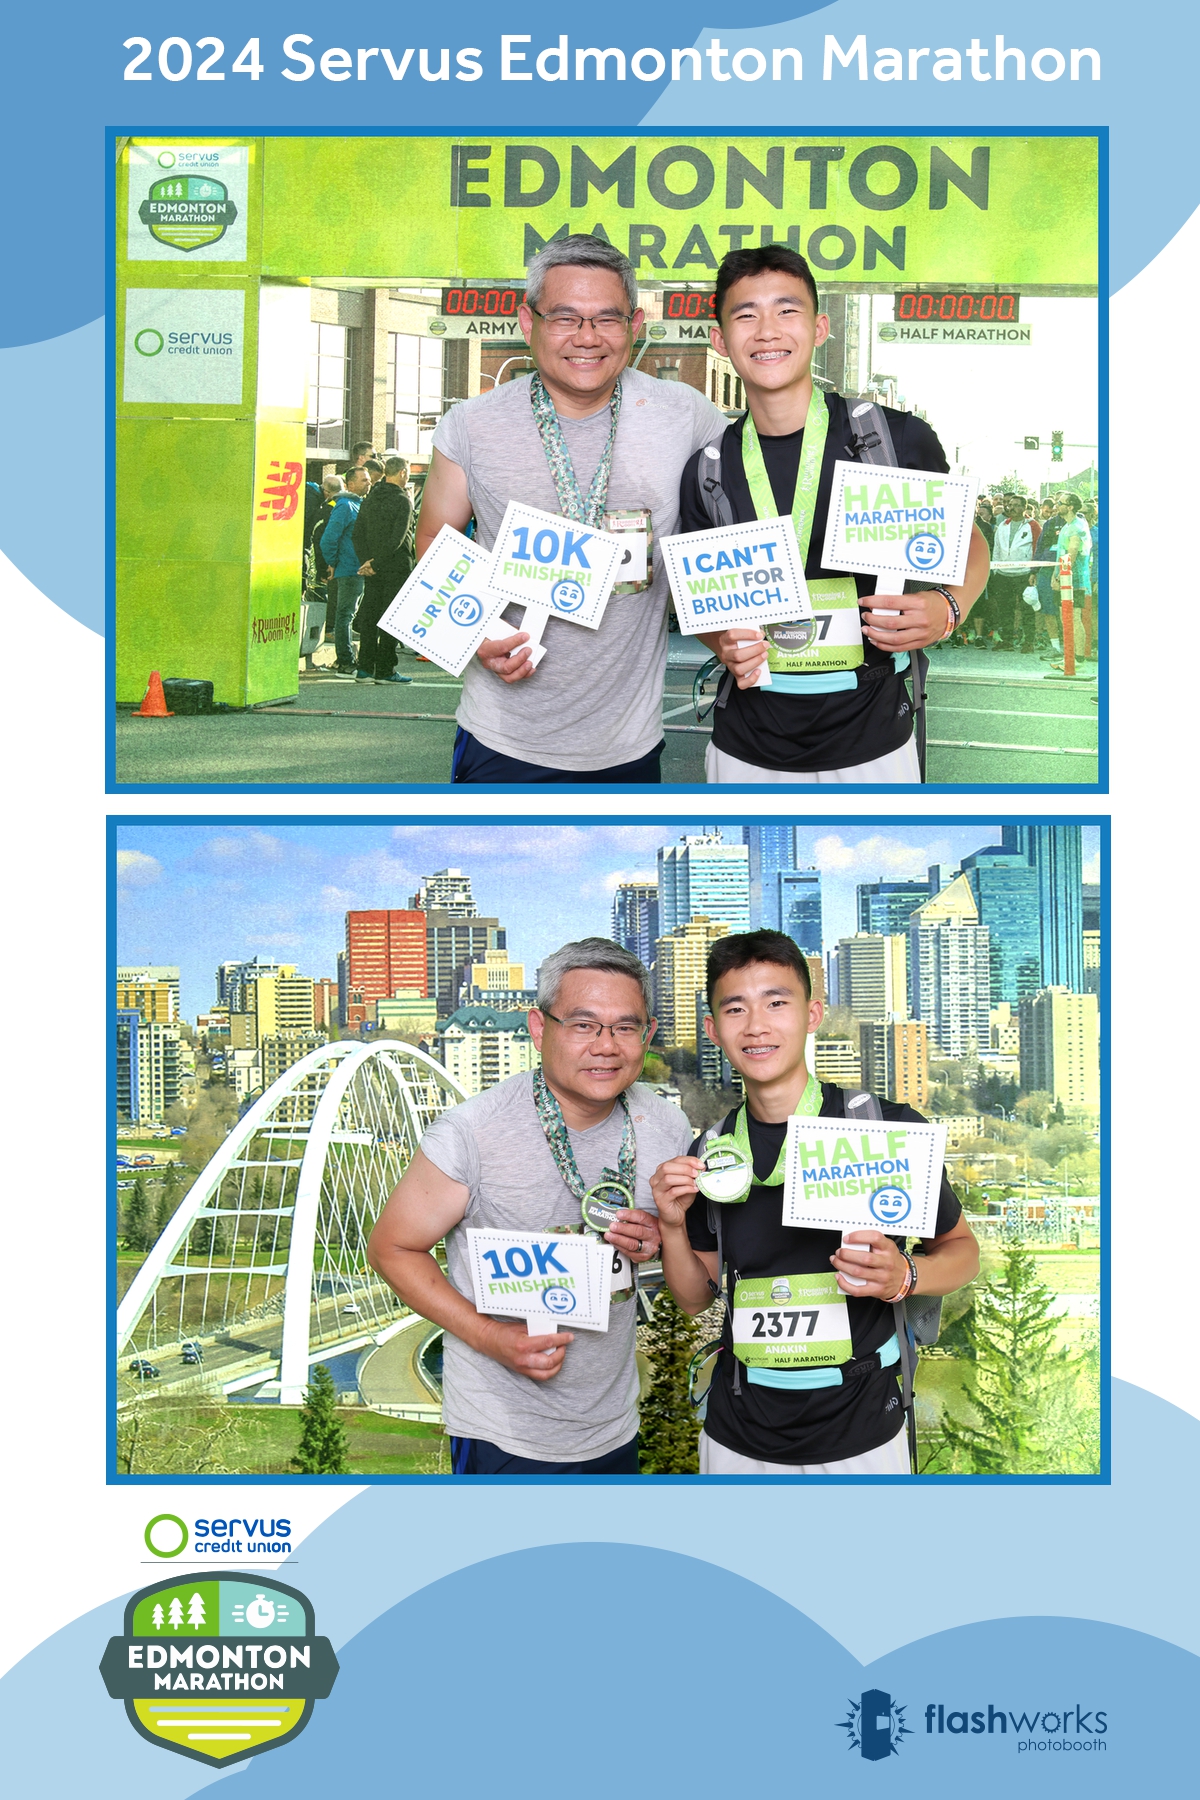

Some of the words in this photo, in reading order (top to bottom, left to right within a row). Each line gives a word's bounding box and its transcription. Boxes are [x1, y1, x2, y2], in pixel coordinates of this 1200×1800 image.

[178, 152, 219, 161] servus
[451, 145, 990, 211] EDMONTON
[149, 203, 226, 213] EDMONTON
[160, 214, 215, 222] MARATHON
[168, 331, 233, 345] servus
[466, 321, 517, 335] ARMY
[679, 325, 711, 339] MA
[900, 328, 938, 339] HALF
[943, 329, 1030, 340] MARATHON
[168, 345, 200, 355] credit
[202, 346, 233, 355] union
[844, 480, 944, 512] HALF
[845, 507, 945, 525] MARATHON
[845, 522, 947, 543] FINISHER!
[512, 526, 594, 569] 10K
[682, 557, 691, 575] I
[695, 542, 777, 573] CAN'T
[503, 561, 592, 587] FINISHER!
[686, 573, 739, 595] WAIT
[742, 567, 785, 587] FOR
[411, 553, 475, 638] SURVIVED!
[420, 579, 434, 591] I
[692, 587, 789, 615] BRUNCH.
[258, 613, 291, 644] Running
[805, 660, 847, 668] MARATHON
[798, 1130, 908, 1168] HALF
[802, 1158, 910, 1183] MARATHON
[803, 1174, 912, 1200] FINISHER!
[482, 1241, 570, 1280] 10K
[488, 1276, 576, 1296] FINISHER!
[752, 1310, 820, 1338] 2377
[765, 1344, 807, 1354] ANAKIN
[793, 1355, 836, 1363] MARATHON
